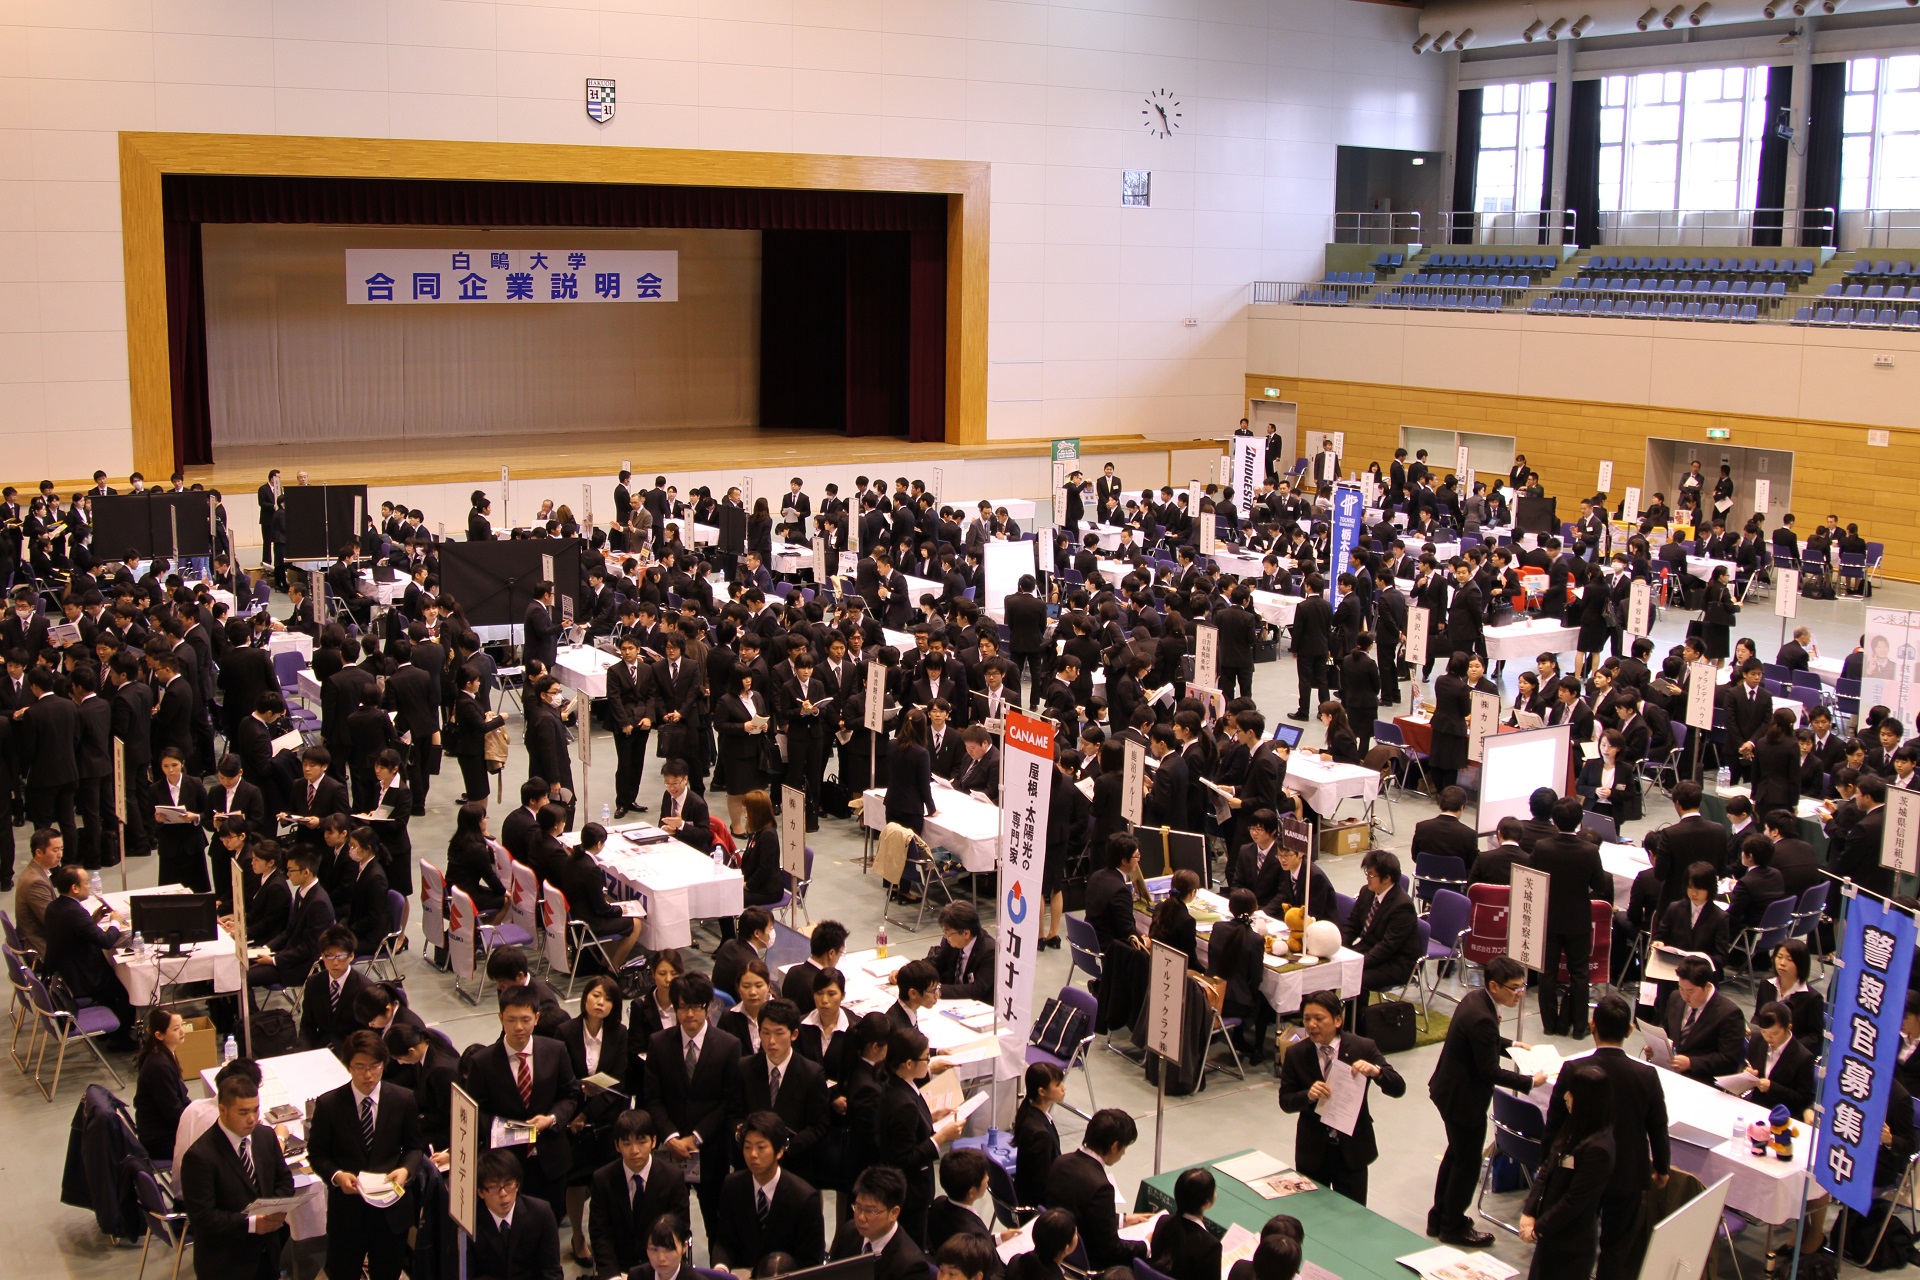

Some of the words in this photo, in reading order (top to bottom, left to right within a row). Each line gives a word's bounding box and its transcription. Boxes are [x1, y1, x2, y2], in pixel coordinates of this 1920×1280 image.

[364, 272, 663, 301] 合同企業説明会
[1243, 444, 1256, 512] BRIDGESTO
[1412, 612, 1422, 661] 滝沢ハム㈱
[1634, 590, 1643, 633] 竹本容器㈱
[1695, 676, 1703, 703] グループ
[1009, 725, 1050, 749] CANAME
[1022, 762, 1040, 871] 屋根・太陽光の
[1129, 750, 1138, 818] 鹿沼グループ
[788, 797, 798, 872] ㈱カナメ
[1009, 811, 1020, 866] 専門家
[1284, 828, 1308, 842] KANUMA
[1894, 796, 1909, 869] 茨城県信用組合
[1471, 944, 1508, 954] 株式会社カンセ
[1519, 877, 1534, 963] 茨城県警察本部
[1002, 927, 1022, 1022] カナメ
[1159, 957, 1172, 1054] アルファクラブ㈱
[1828, 927, 1895, 1184] 警察官募集中
[459, 1105, 469, 1222] ㈱アカデミー
